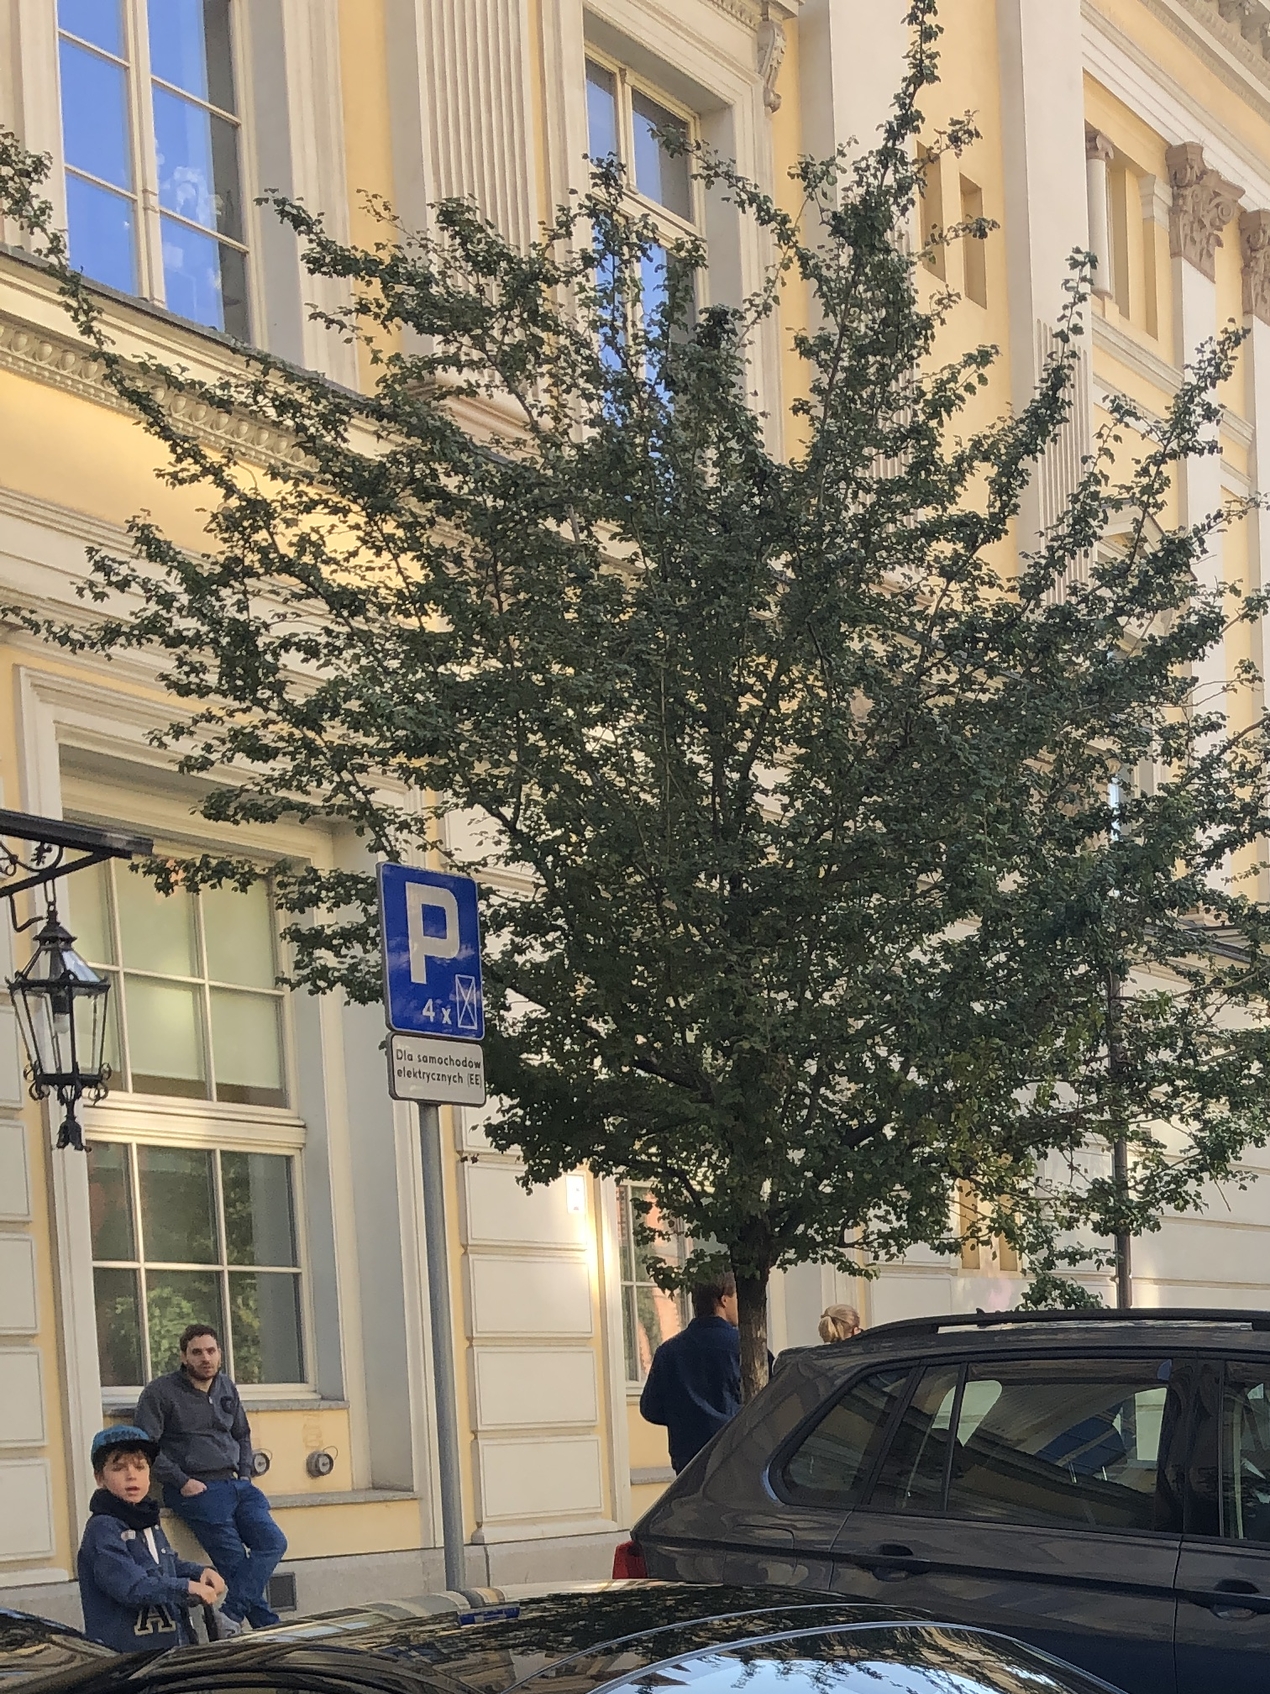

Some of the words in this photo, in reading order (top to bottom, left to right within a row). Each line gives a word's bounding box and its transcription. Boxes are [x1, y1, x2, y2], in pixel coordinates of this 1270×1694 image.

[405, 881, 459, 985] P
[422, 998, 435, 1023] 4
[441, 1007, 452, 1025] x
[396, 1048, 413, 1062] Dla
[417, 1054, 481, 1069] samochodów
[397, 1066, 463, 1085] elektrycznych
[133, 1603, 177, 1636] A
